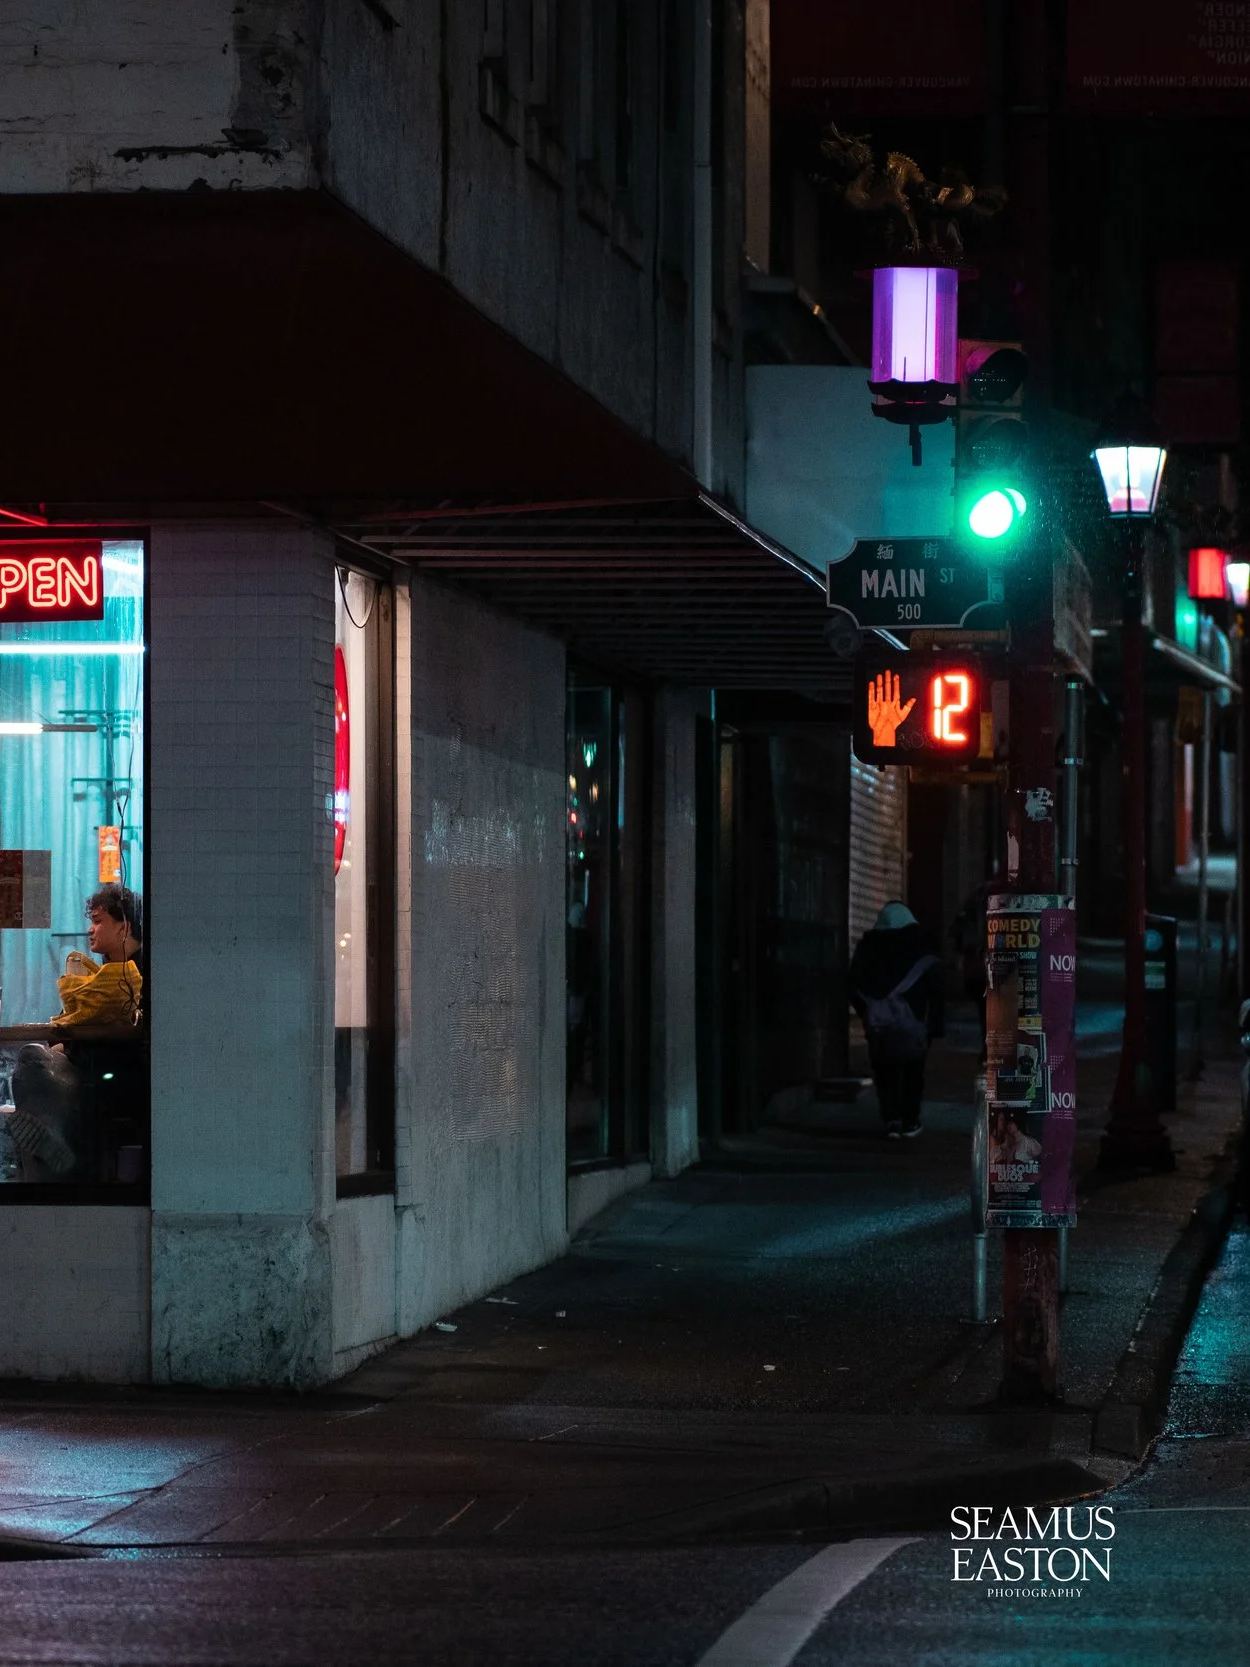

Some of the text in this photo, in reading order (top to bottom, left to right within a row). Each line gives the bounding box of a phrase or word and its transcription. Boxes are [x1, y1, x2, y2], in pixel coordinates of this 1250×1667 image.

[861, 567, 955, 598] MAIN ST
[897, 603, 922, 620] 500
[933, 674, 969, 741] 12
[987, 918, 1041, 932] COMEDY
[1019, 951, 1037, 960] SHOW
